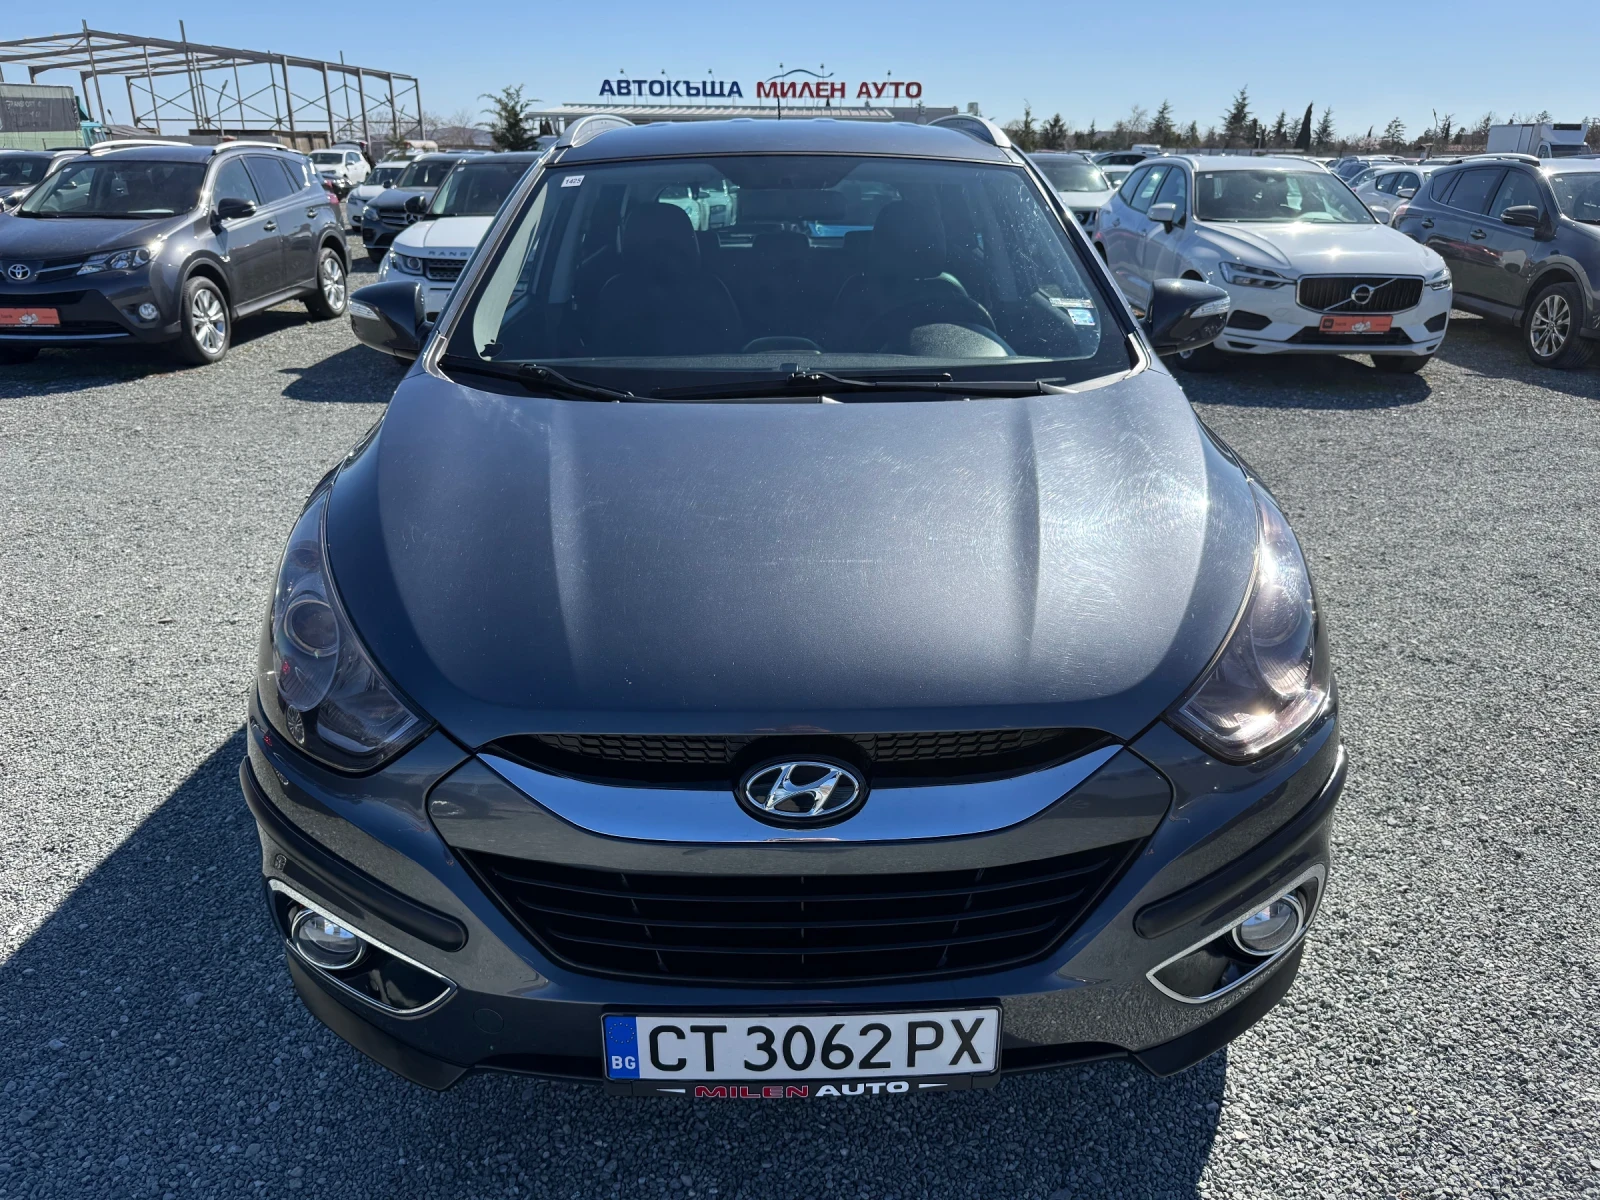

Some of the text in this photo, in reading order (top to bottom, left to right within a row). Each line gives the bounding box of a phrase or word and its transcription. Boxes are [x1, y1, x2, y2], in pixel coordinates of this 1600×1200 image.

[756, 81, 846, 99] МИЛЕН
[856, 81, 923, 99] АУТО
[611, 1017, 985, 1073] BG CT 3062 PX
[694, 1080, 910, 1099] MILEN AUTO
